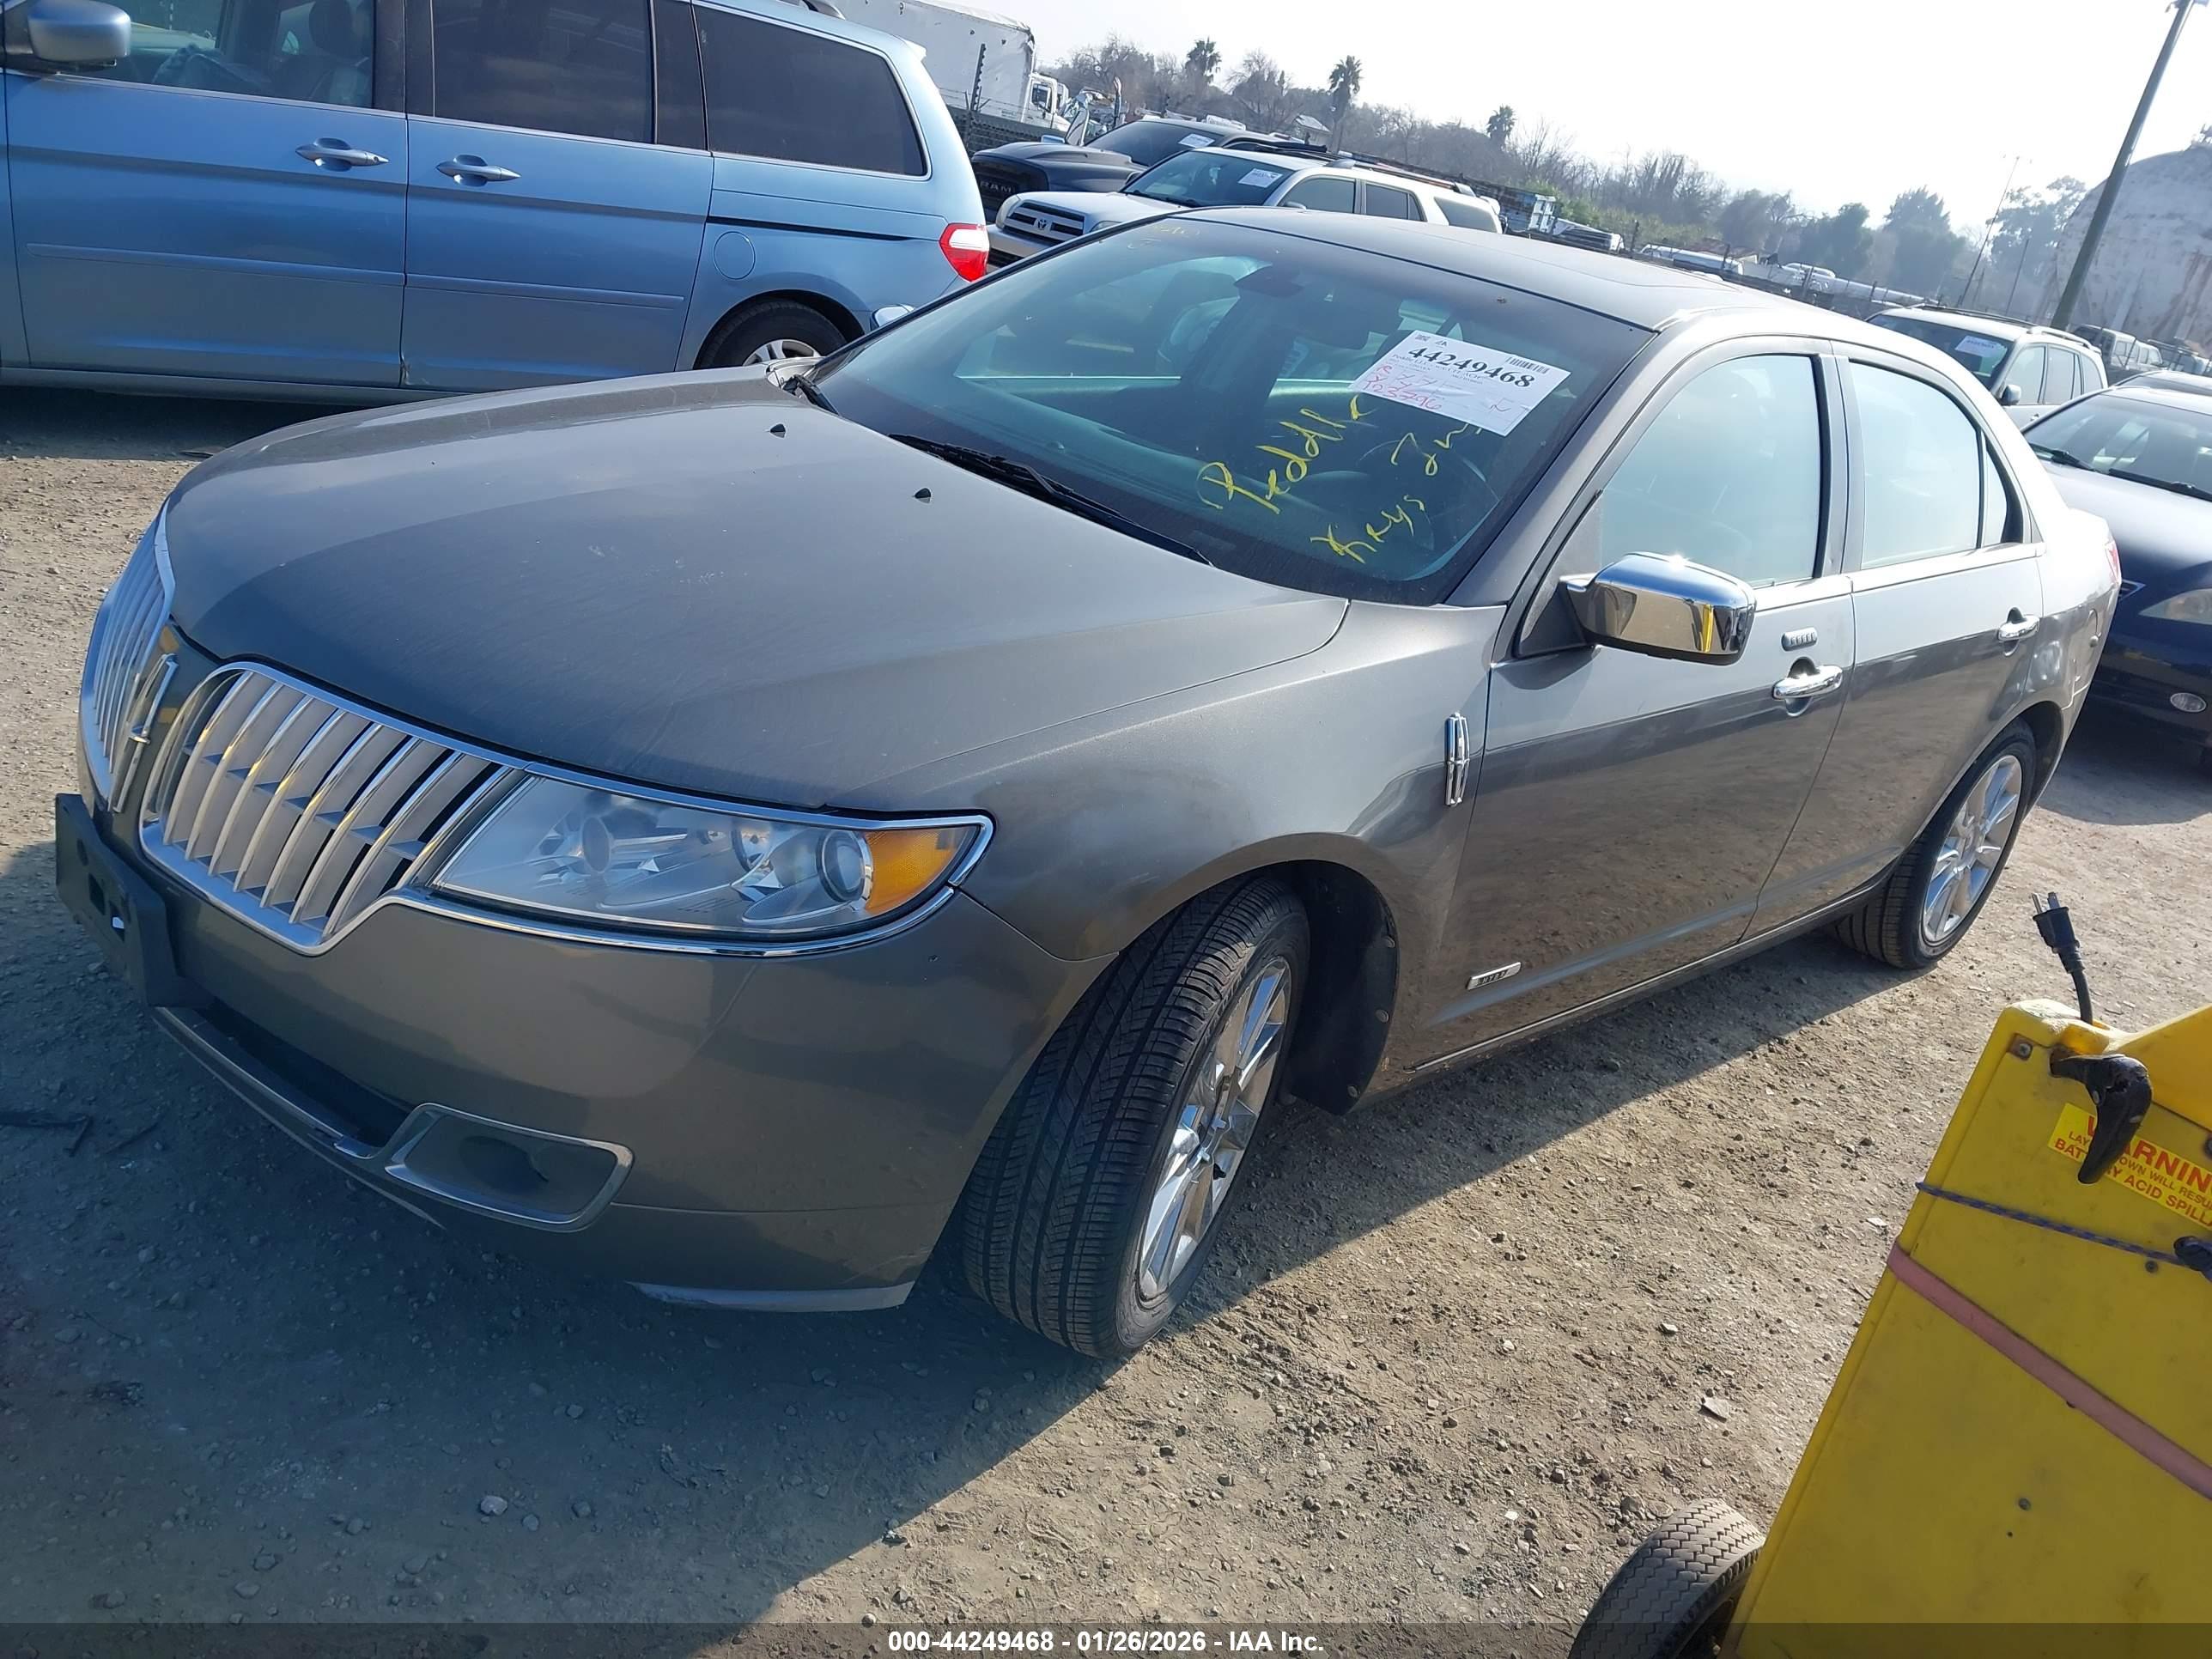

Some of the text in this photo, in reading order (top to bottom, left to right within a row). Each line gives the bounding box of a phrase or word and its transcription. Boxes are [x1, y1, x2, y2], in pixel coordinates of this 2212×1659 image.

[980, 180, 1012, 193] RAM
[1408, 347, 1535, 387] 44249468
[2124, 1175, 2162, 1199] ACID
[2149, 1170, 2175, 1190] WILL
